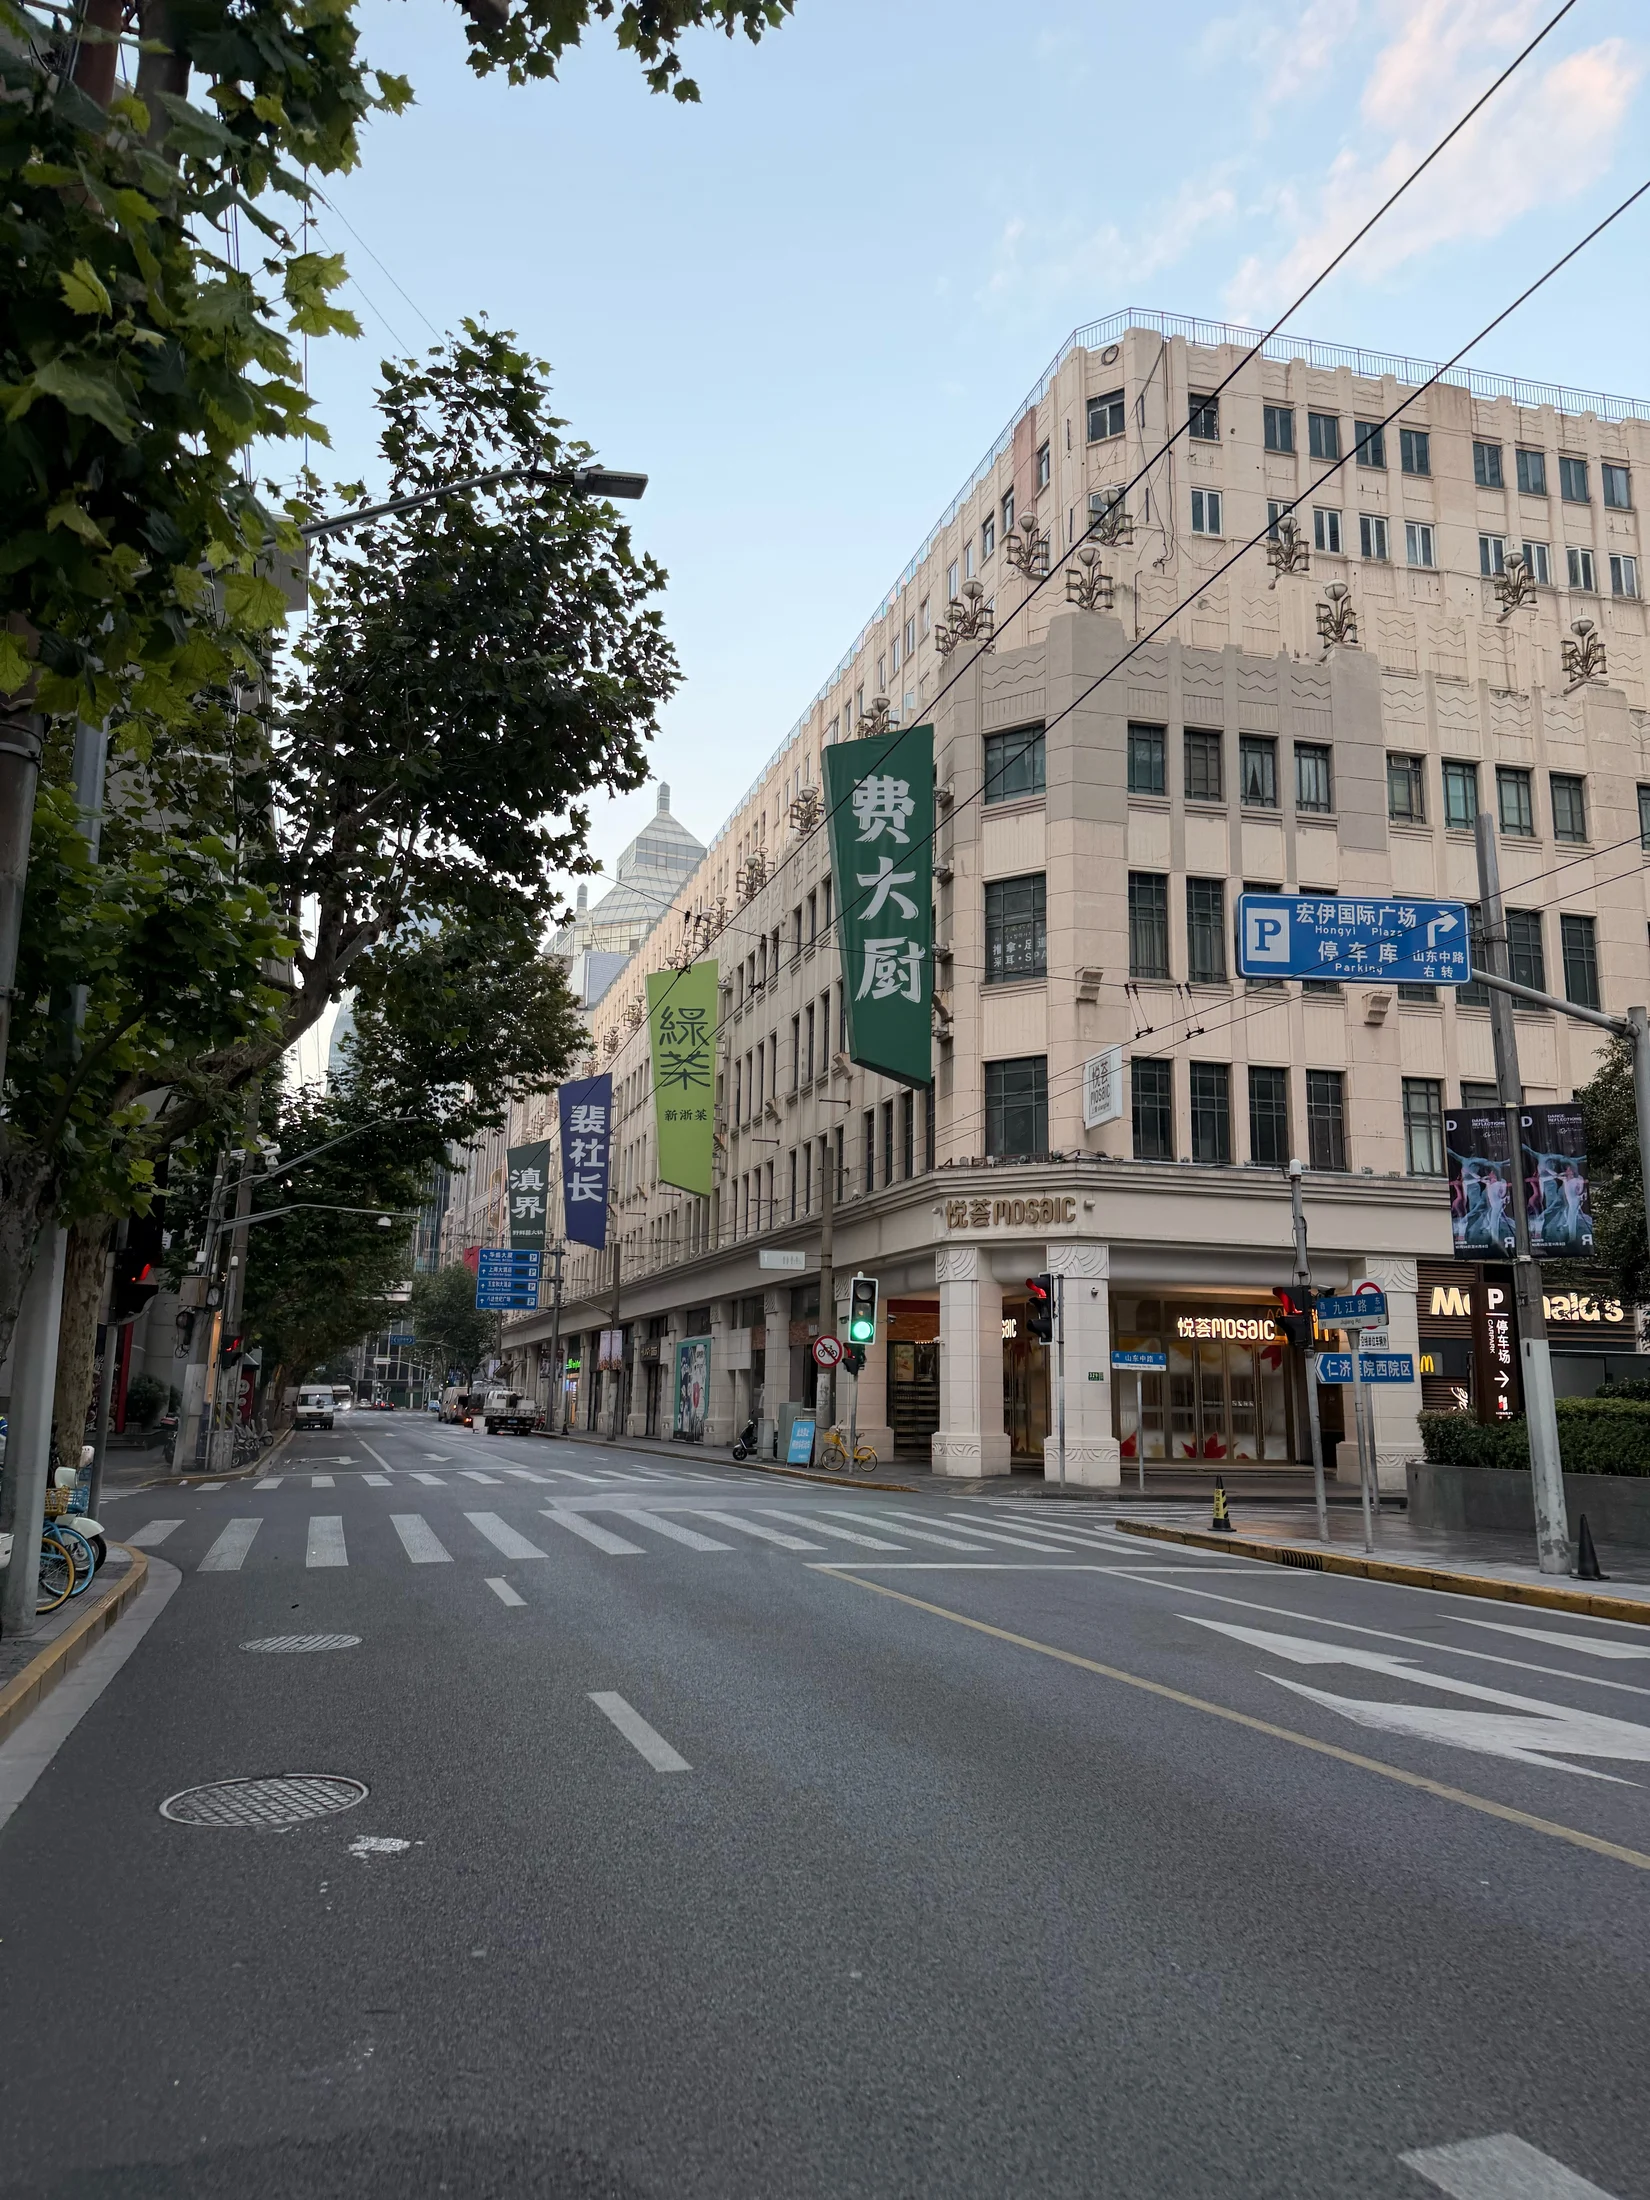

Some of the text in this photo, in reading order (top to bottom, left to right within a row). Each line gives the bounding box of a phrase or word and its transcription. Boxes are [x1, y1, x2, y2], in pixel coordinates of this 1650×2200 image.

[850, 774, 927, 1004] 费大厨
[1296, 903, 1417, 927] 宏伊国际广场
[1255, 918, 1281, 951] P
[1315, 925, 1402, 937] Hongyi Plaza
[1318, 940, 1398, 963] 停车库
[1413, 950, 1465, 964] 山东中路
[1335, 962, 1383, 975] Parking
[1423, 965, 1454, 978] 右转
[664, 1109, 708, 1121] 新浙菜
[1446, 1121, 1457, 1131] D
[1521, 1117, 1533, 1127] D
[568, 1105, 606, 1203] 裴社长
[510, 1168, 546, 1219] 滇界
[1333, 1299, 1367, 1315] 九江路
[1487, 1288, 1504, 1310] P
[1487, 1319, 1496, 1354] CARPARK
[1495, 1319, 1511, 1364] 停车场
